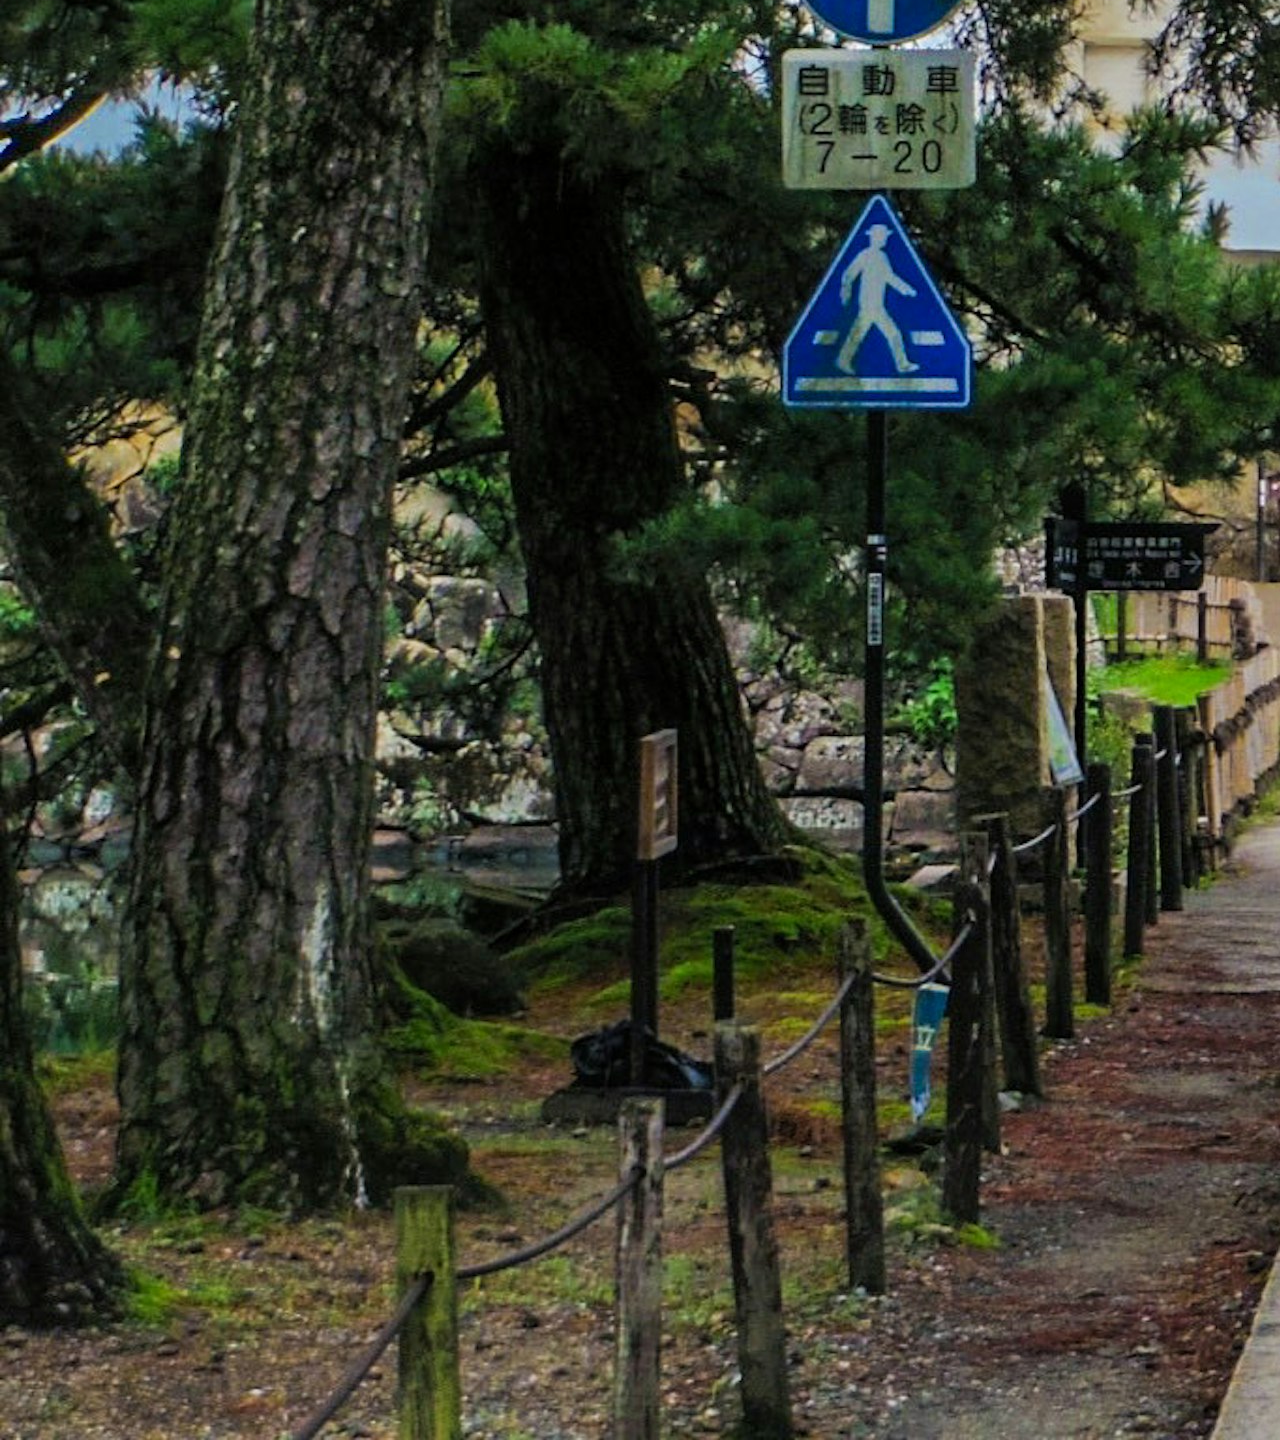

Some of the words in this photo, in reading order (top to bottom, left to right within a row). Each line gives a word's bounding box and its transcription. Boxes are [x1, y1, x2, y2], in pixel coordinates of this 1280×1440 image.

[798, 64, 959, 97] 自動車
[798, 102, 959, 136] (2輪を除く)
